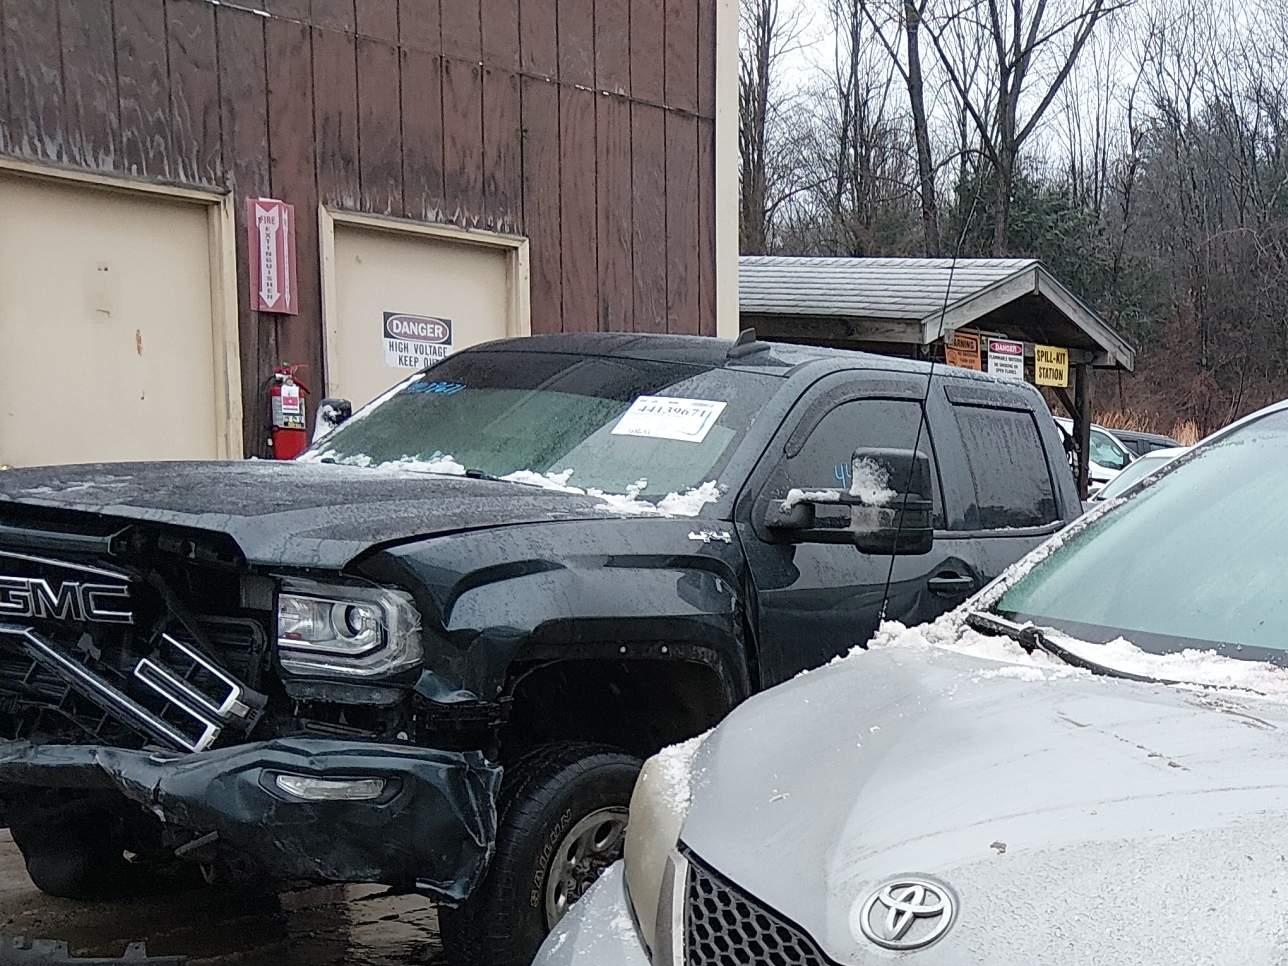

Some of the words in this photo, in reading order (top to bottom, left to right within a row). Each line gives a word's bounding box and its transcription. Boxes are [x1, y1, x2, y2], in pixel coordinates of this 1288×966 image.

[258, 215, 276, 225] FIRE
[392, 319, 444, 338] DANGER
[388, 340, 409, 353] HIGH
[413, 343, 448, 358] VOLTAGE
[398, 354, 419, 367] KEEP
[1036, 350, 1066, 365] SPILL-KIT
[1038, 366, 1064, 381] STATION
[0, 575, 134, 624] GMC
